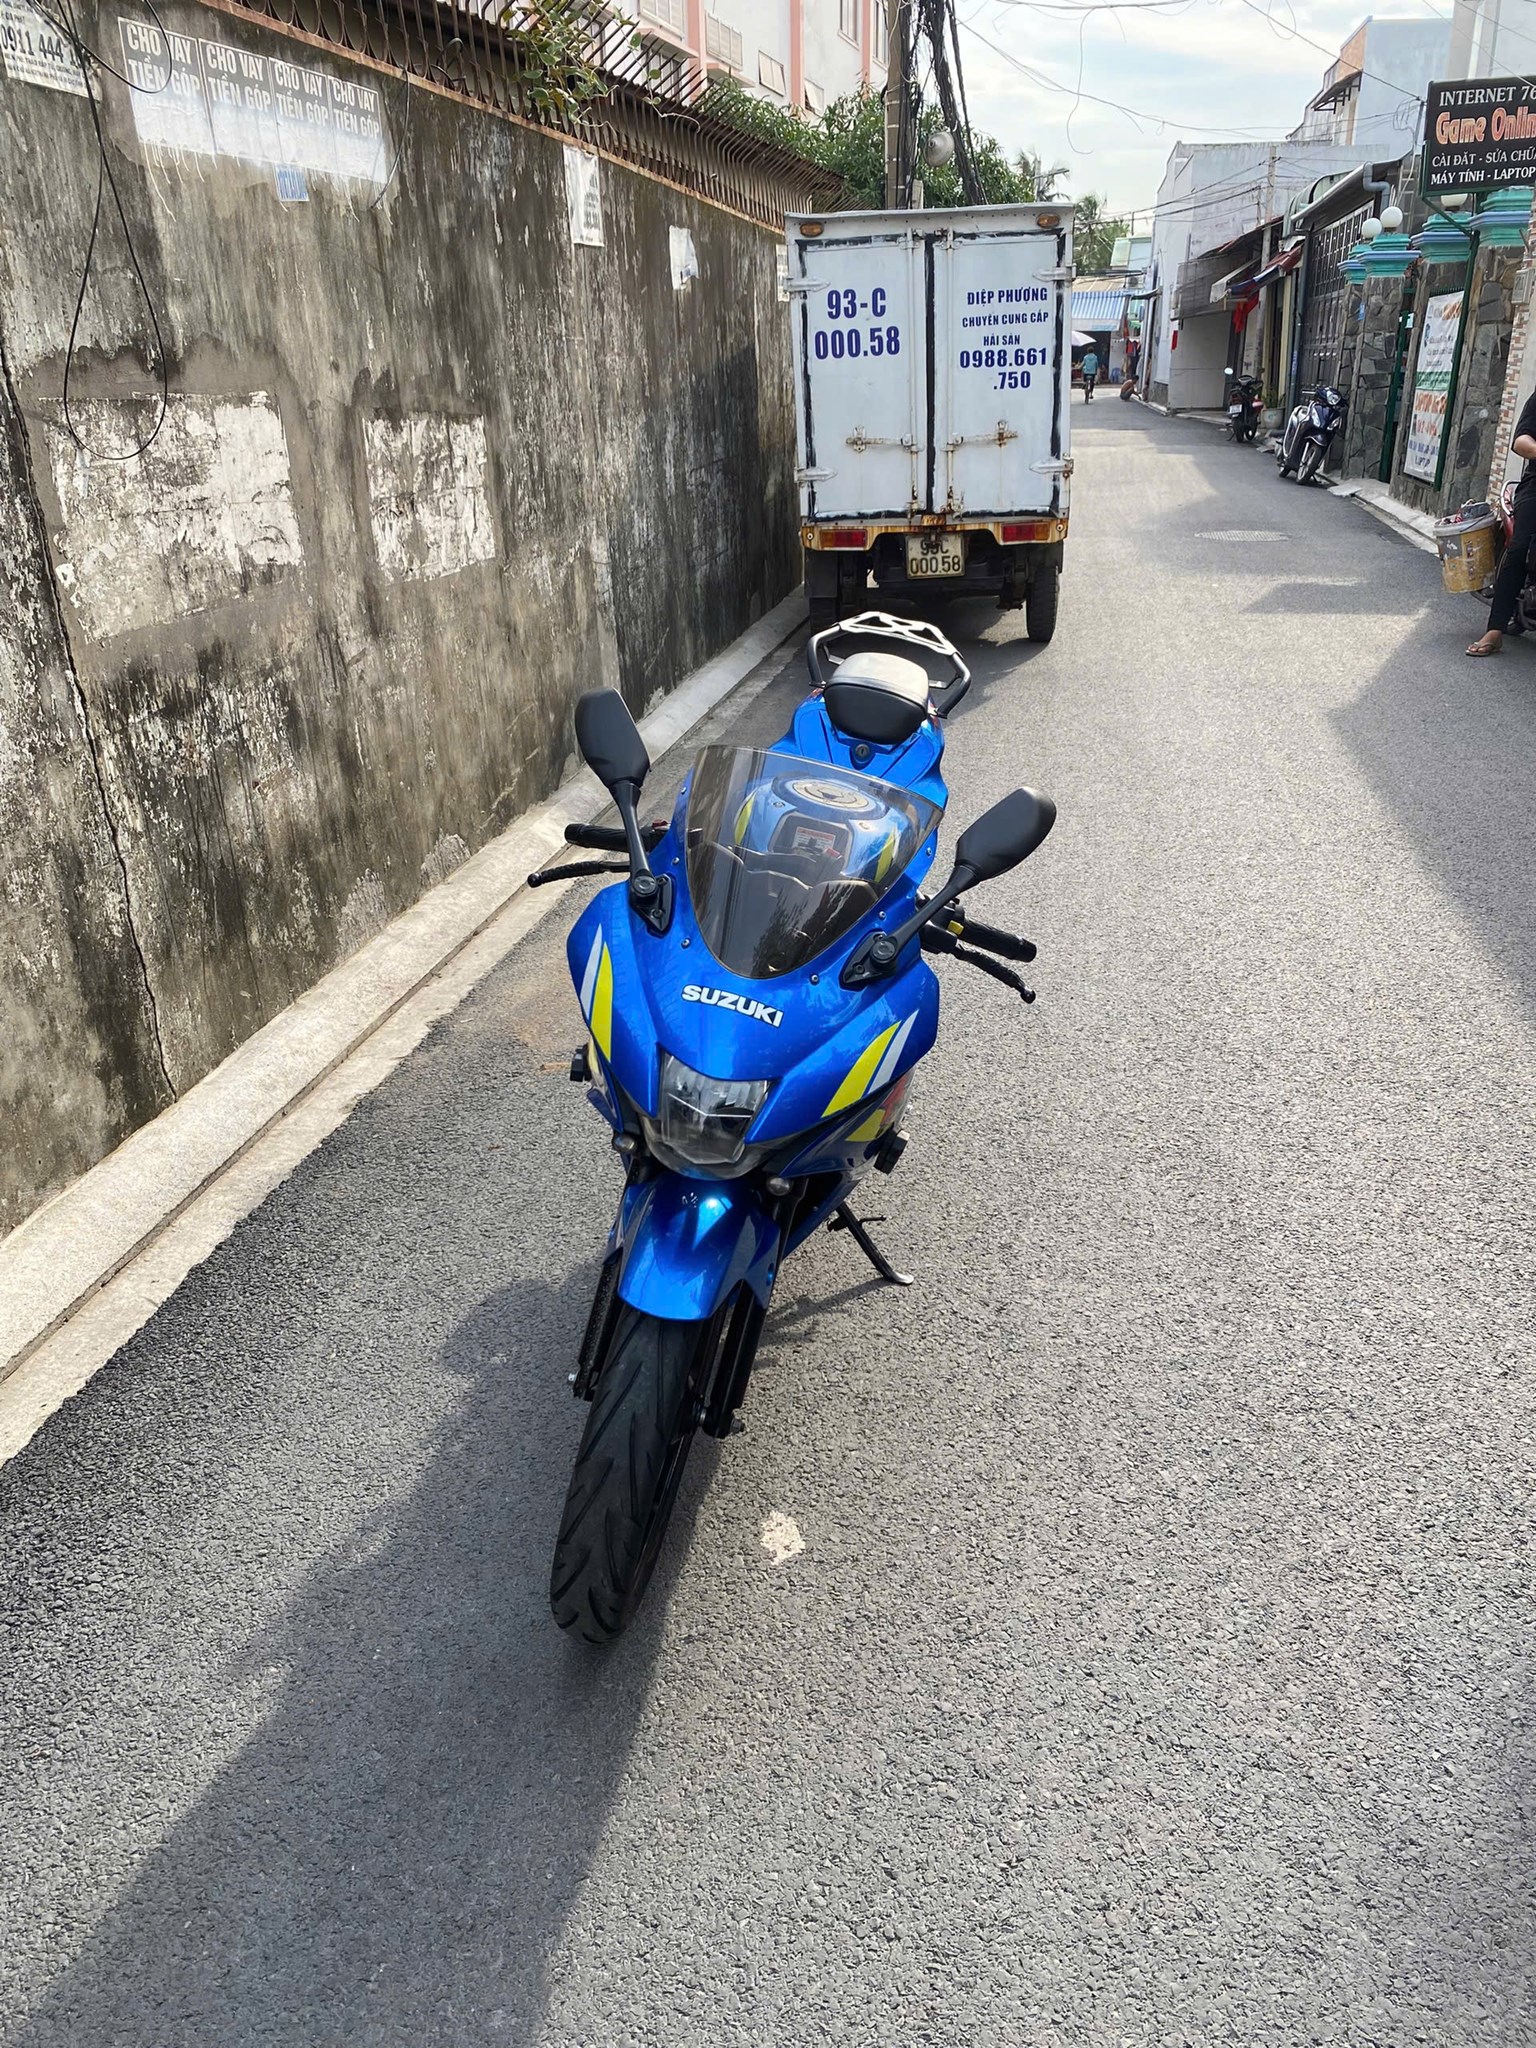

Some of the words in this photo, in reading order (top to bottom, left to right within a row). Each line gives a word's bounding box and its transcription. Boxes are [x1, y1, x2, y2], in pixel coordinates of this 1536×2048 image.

[38, 33, 65, 63] 444
[126, 23, 162, 56] CHO
[165, 34, 193, 65] VAY
[206, 44, 237, 74] CHO
[239, 52, 264, 81] VAY
[275, 61, 300, 91] CHO
[302, 71, 323, 98] VAY
[244, 83, 271, 112] GÓP
[332, 80, 355, 107] CHO
[357, 88, 375, 113] VAY
[1440, 86, 1517, 107] INTERNET
[1435, 111, 1486, 144] Game
[1432, 152, 1451, 167] CÀI
[1430, 169, 1456, 185] MÁY
[1458, 168, 1485, 183] TÍNH
[1493, 166, 1536, 180] LAPTOP
[827, 287, 886, 320] 93-C
[967, 288, 995, 307] ĐIỆP
[998, 286, 1048, 304] PHƯỢNG
[962, 313, 999, 328] CHUYÊN
[1001, 313, 1028, 325] CUNG
[814, 325, 900, 360] 000.58
[960, 347, 1047, 369] 0988.661
[993, 370, 1031, 390] .750
[910, 554, 961, 575] 000.58
[681, 984, 784, 1028] SUZUKI
